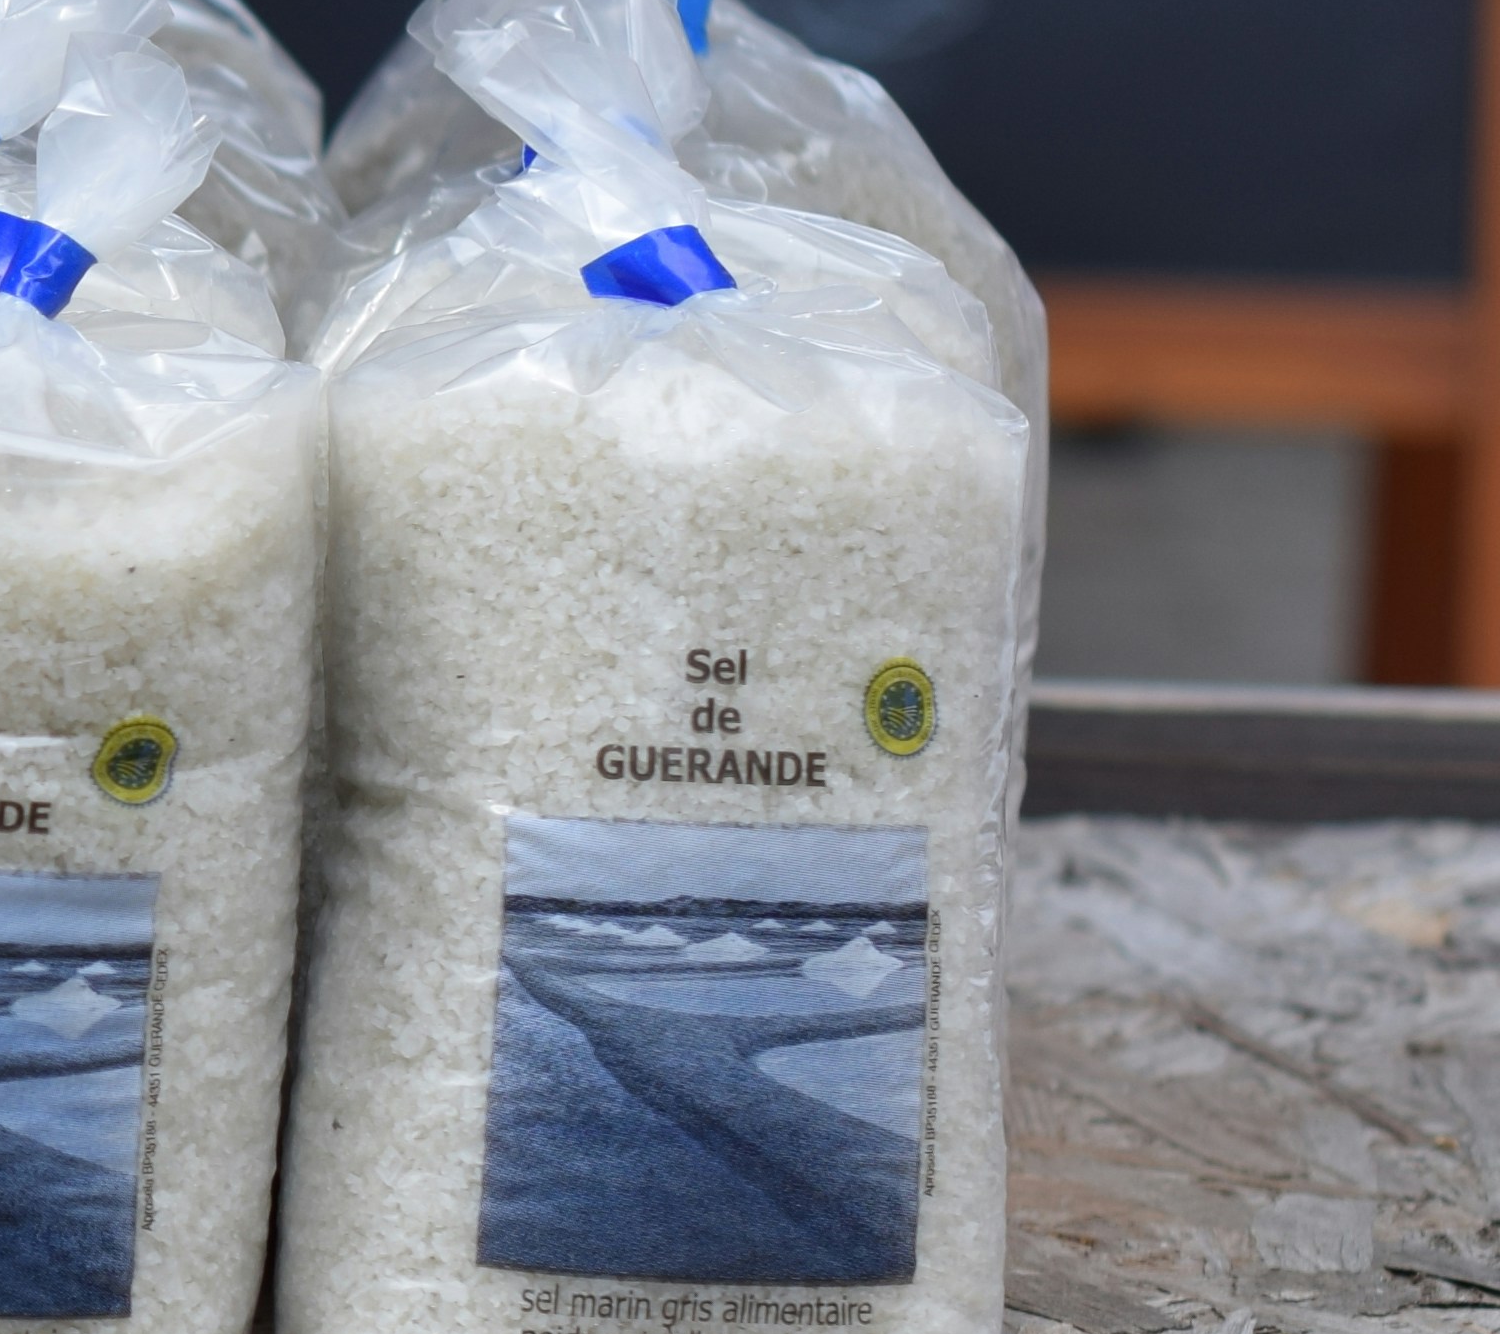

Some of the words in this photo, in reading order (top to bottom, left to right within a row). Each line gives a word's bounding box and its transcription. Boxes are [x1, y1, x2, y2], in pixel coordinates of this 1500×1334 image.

[686, 649, 747, 686] Sel
[692, 699, 742, 734] de
[597, 745, 828, 788] GUERANDE
[520, 1284, 558, 1314] sel
[572, 1291, 651, 1320] marin
[663, 1294, 711, 1327] gris
[723, 1295, 872, 1326] alimentaire
